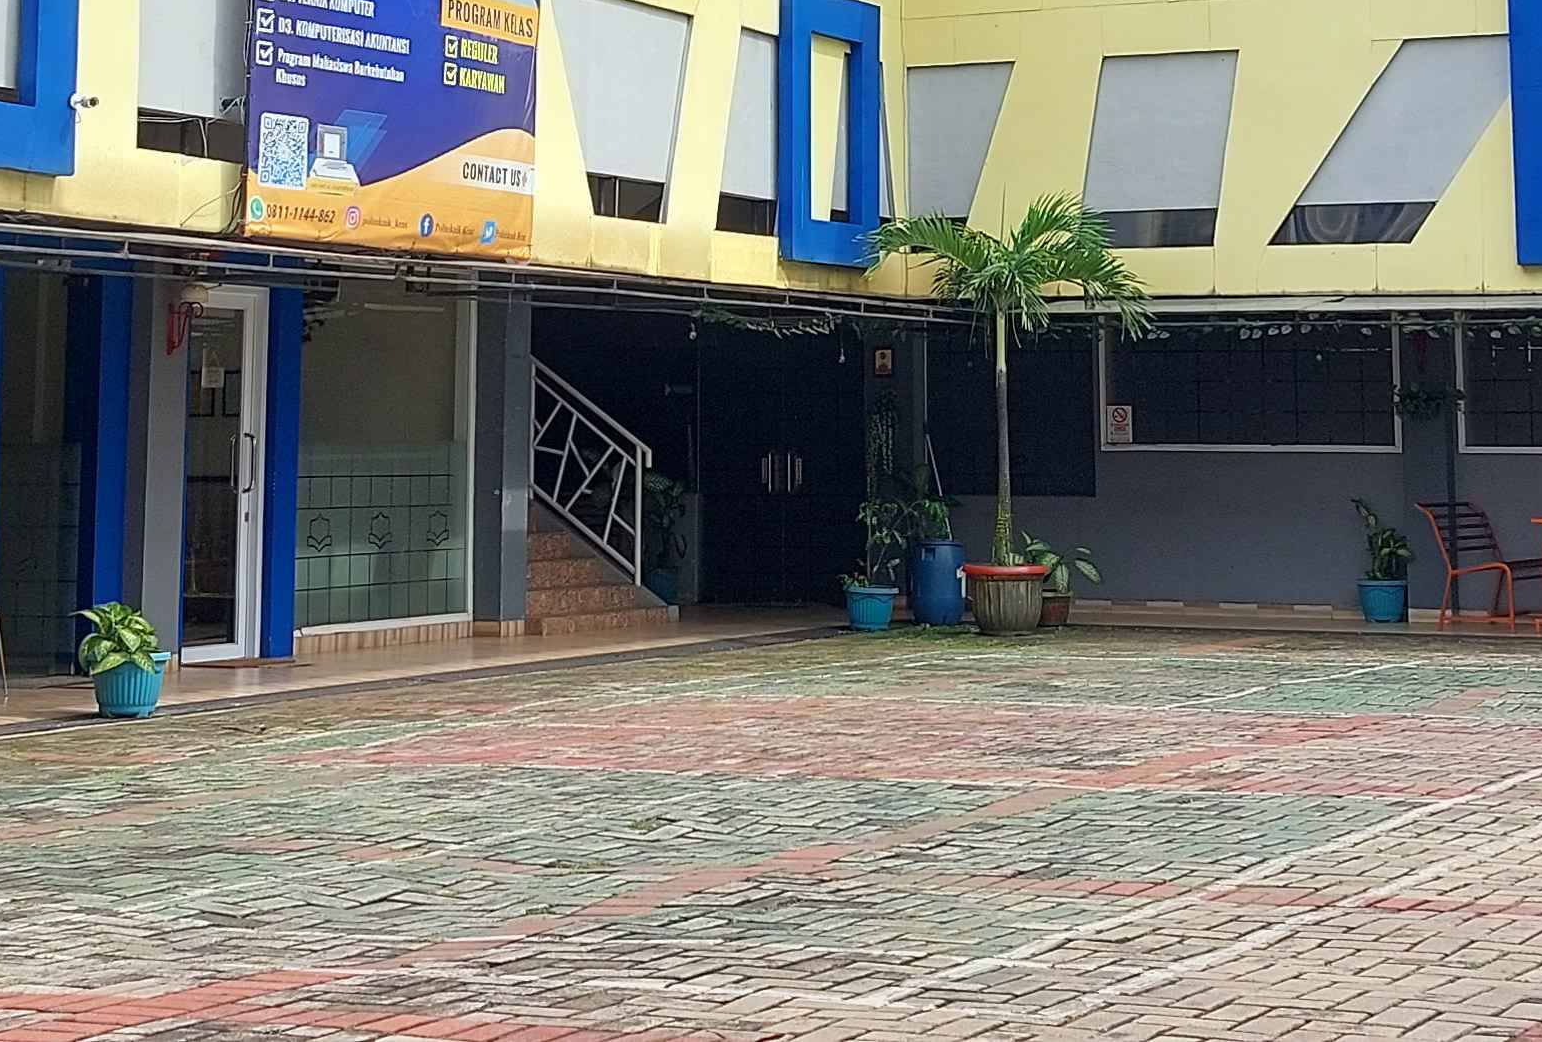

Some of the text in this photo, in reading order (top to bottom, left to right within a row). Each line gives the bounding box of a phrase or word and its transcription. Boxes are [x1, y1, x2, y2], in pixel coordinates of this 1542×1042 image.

[448, 0, 534, 38] PROGRAM KELAS
[296, 20, 364, 48] KOMPUTERISASI
[365, 32, 410, 54] AKUNTANSI
[278, 48, 311, 67] Program
[461, 38, 498, 65] REGULER
[459, 67, 506, 94] KARYAWAN
[463, 162, 508, 185] CONTACT
